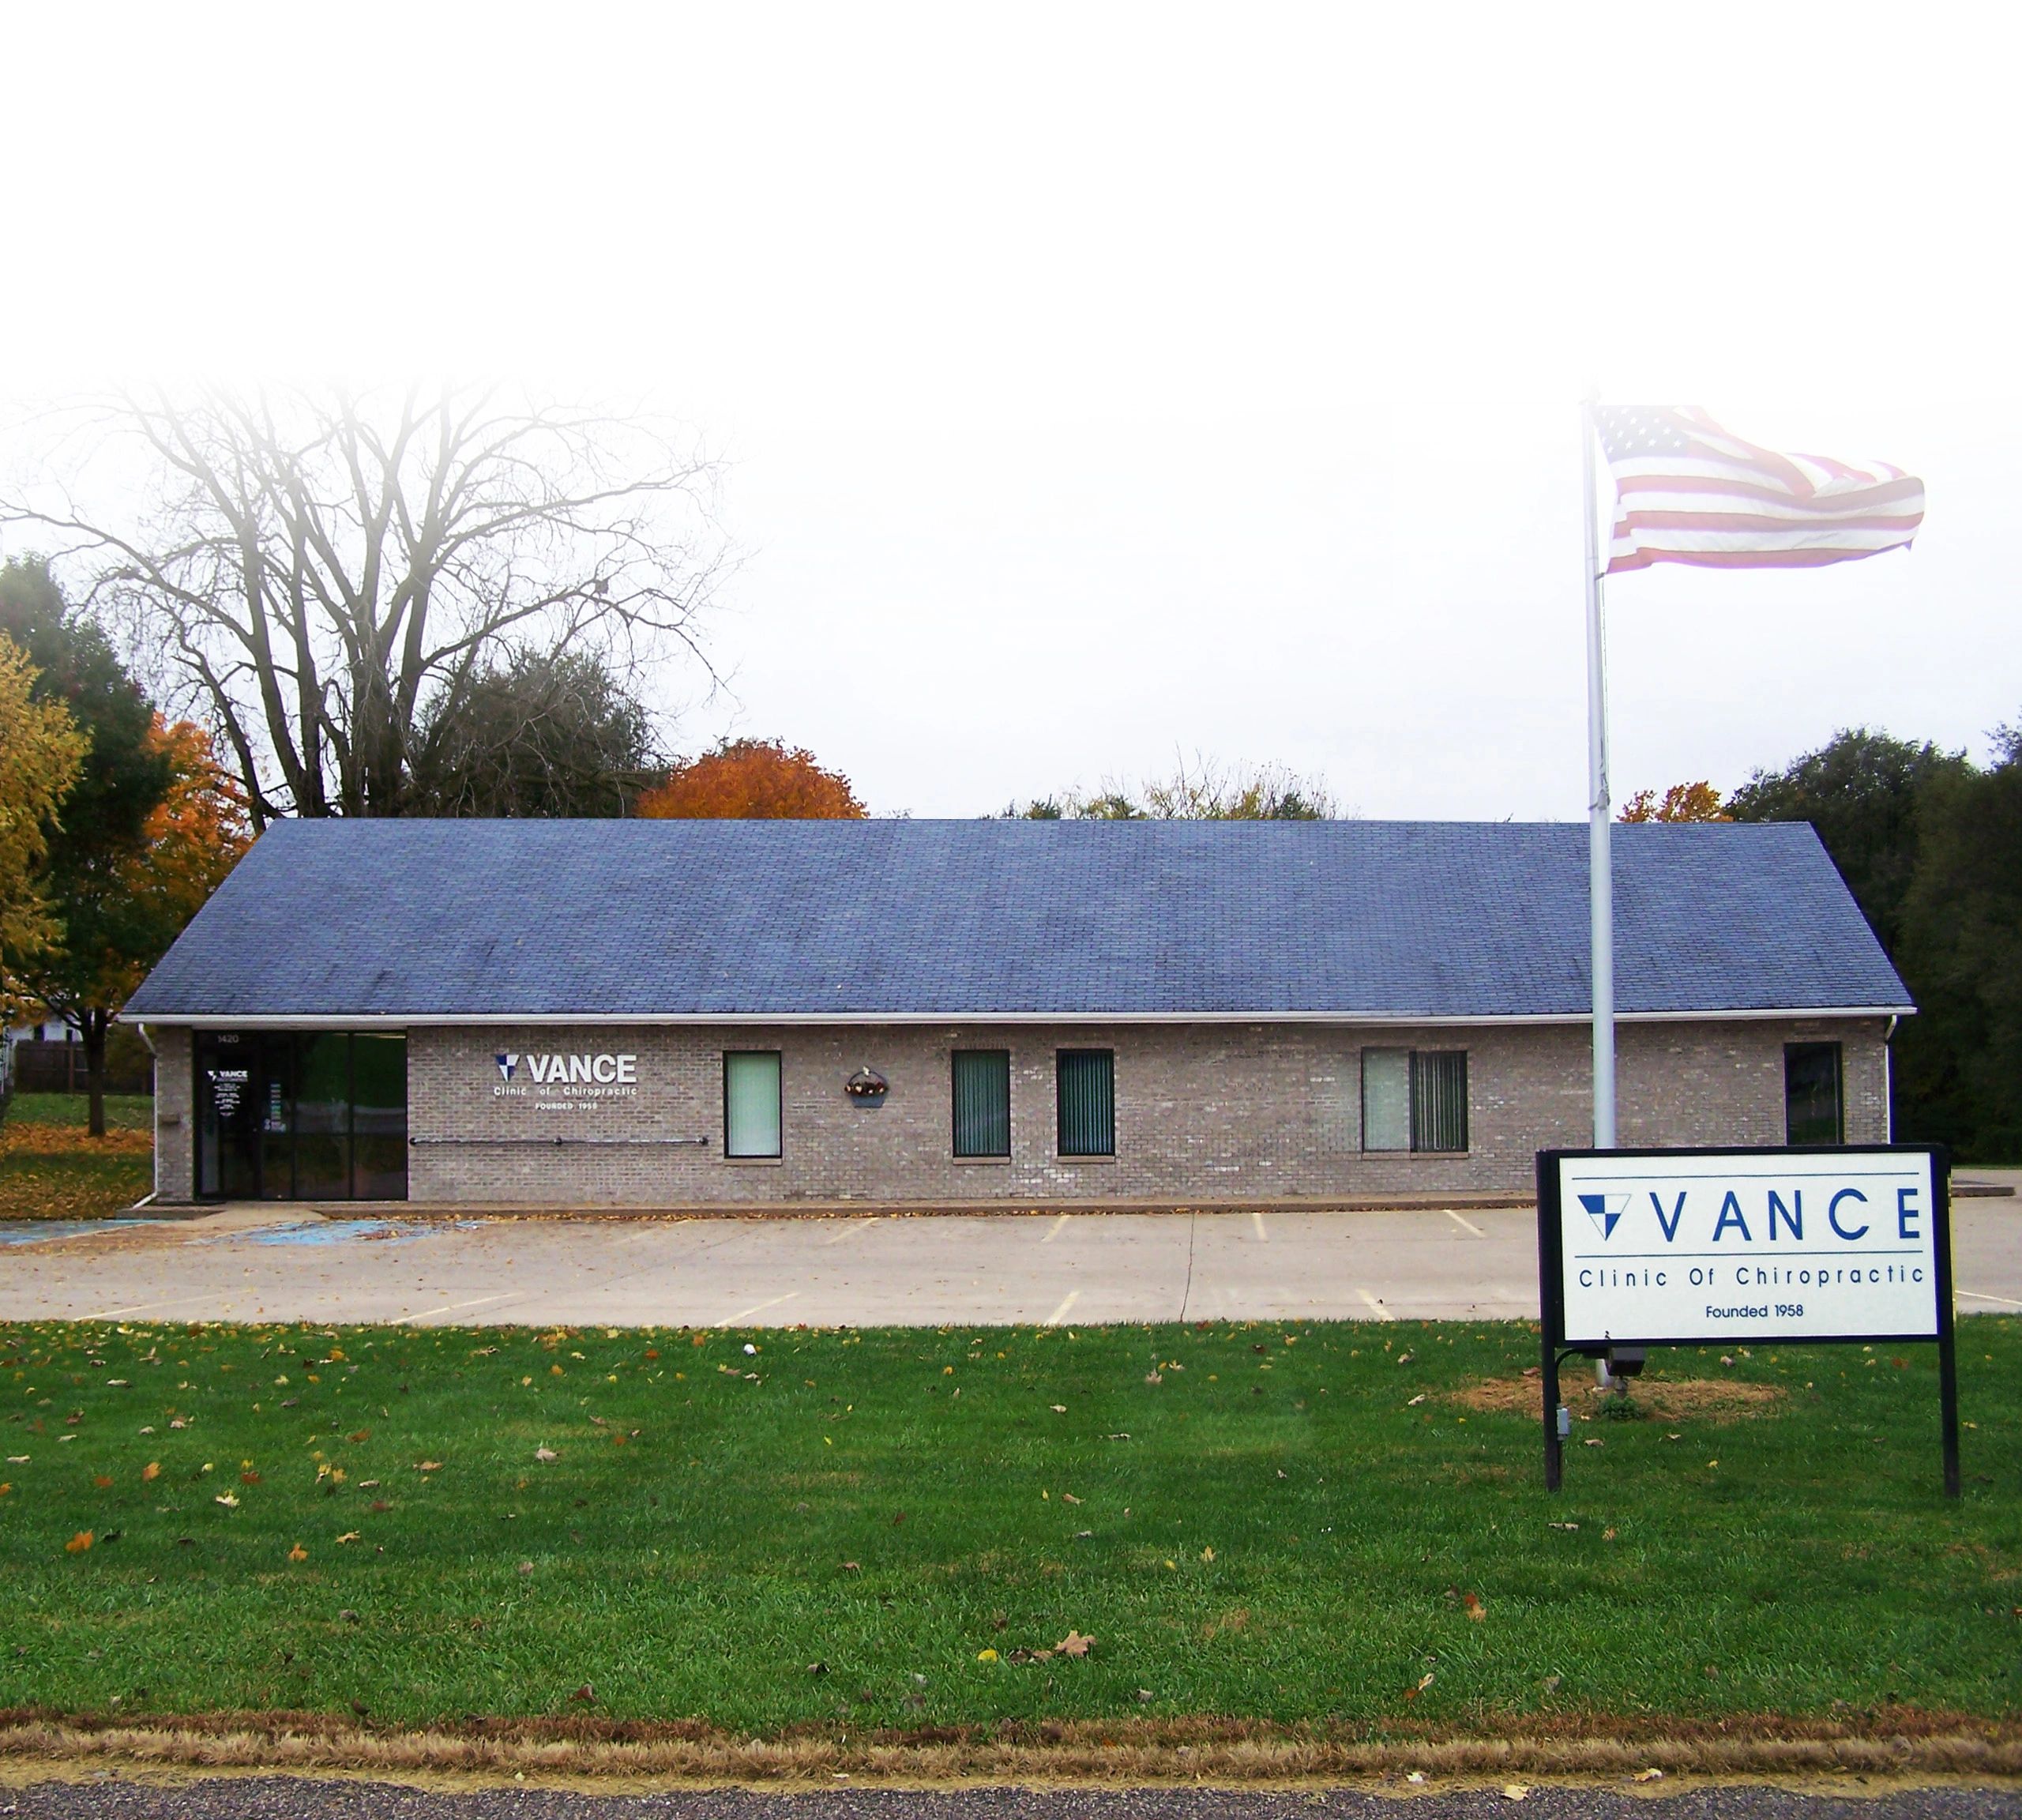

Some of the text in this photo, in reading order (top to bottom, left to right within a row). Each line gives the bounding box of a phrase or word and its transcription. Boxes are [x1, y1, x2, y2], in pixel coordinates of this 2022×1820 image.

[526, 1054, 638, 1083] VANCE
[494, 1085, 637, 1097] Clinic of Chiropractic
[535, 1102, 573, 1111] FOUNDED
[1648, 1187, 1921, 1243] VANCE
[1579, 1265, 1923, 1288] Clinic Of Chiropractic
[1705, 1303, 1804, 1318] Founded 1958
